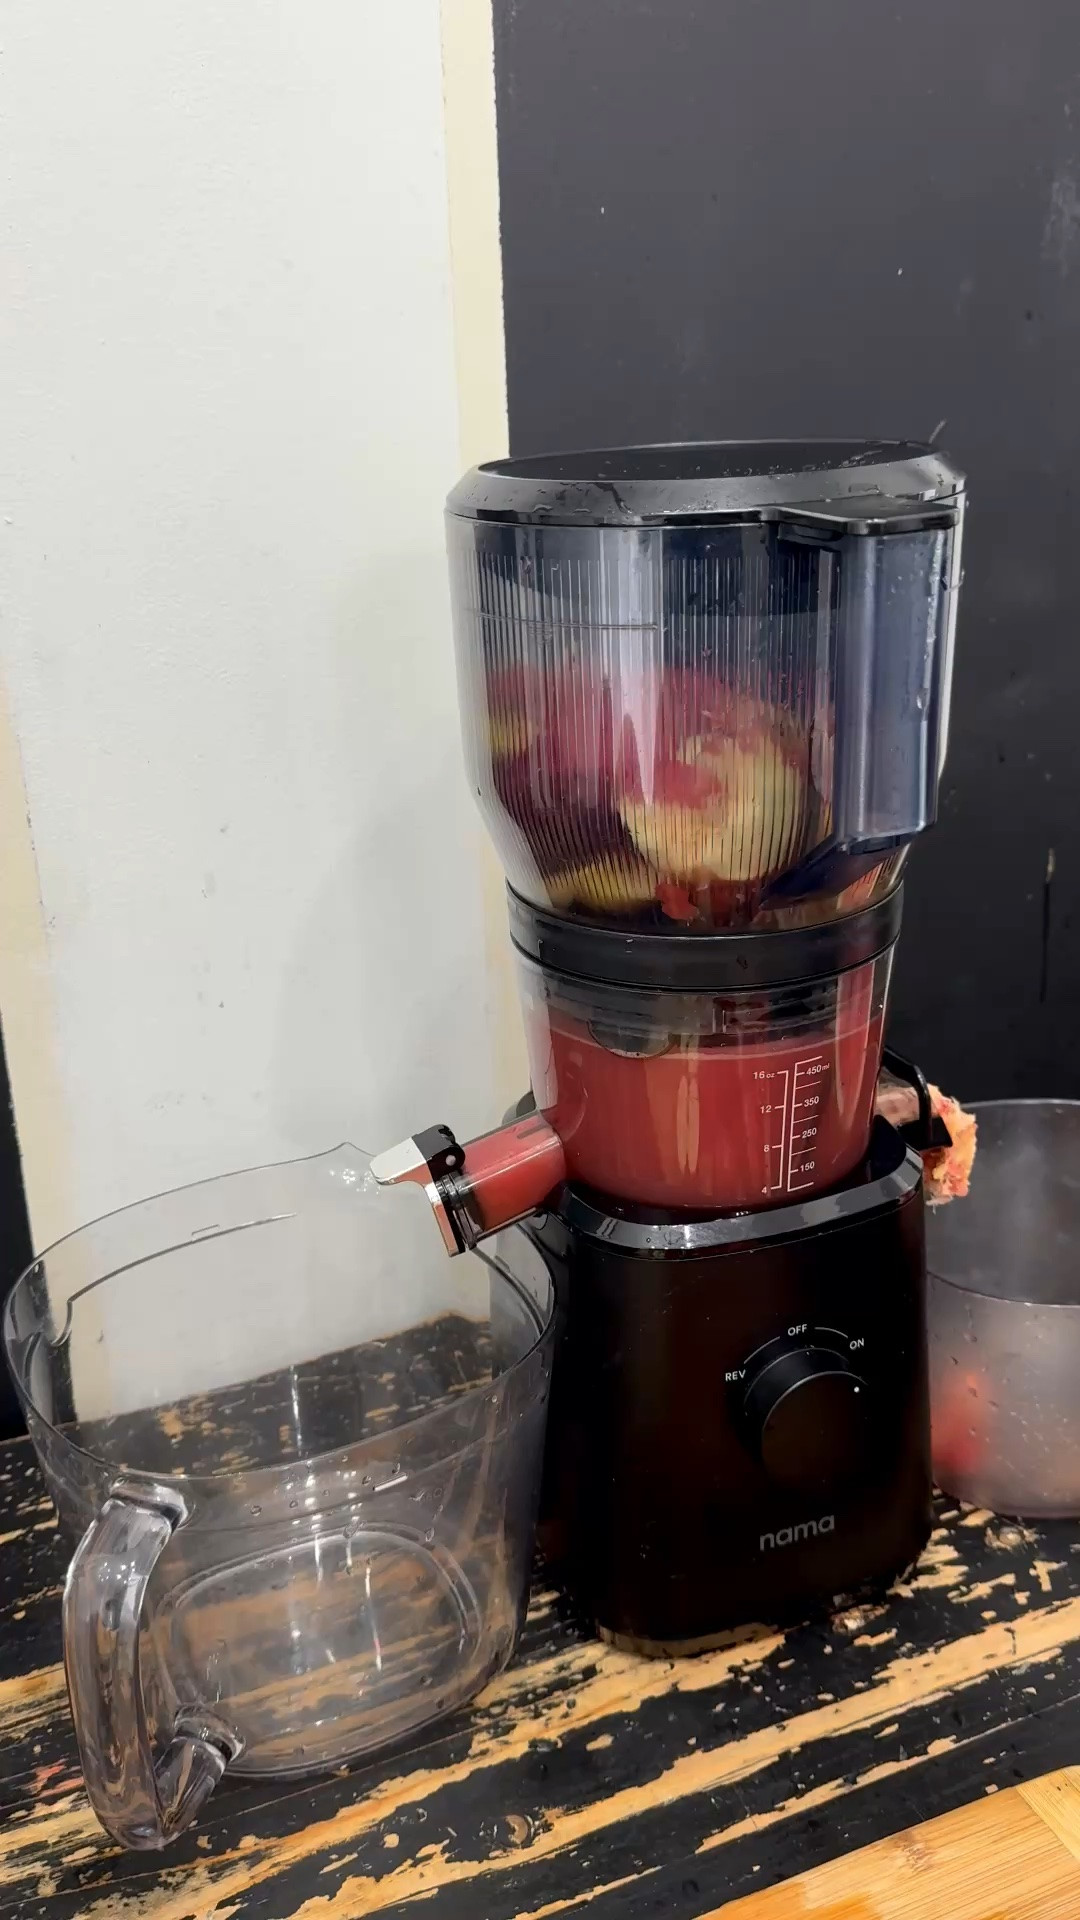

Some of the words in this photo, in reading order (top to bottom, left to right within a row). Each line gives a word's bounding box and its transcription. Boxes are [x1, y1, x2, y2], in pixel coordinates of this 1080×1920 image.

[804, 1096, 820, 1107] 350
[760, 1105, 772, 1114] 12
[802, 1127, 817, 1139] 250
[763, 1144, 770, 1152] 8
[800, 1161, 815, 1172] 150
[761, 1186, 768, 1194] 4
[787, 1324, 808, 1336] OFF
[850, 1338, 865, 1350] ON
[725, 1369, 747, 1382] REV
[760, 1515, 835, 1552] nama
